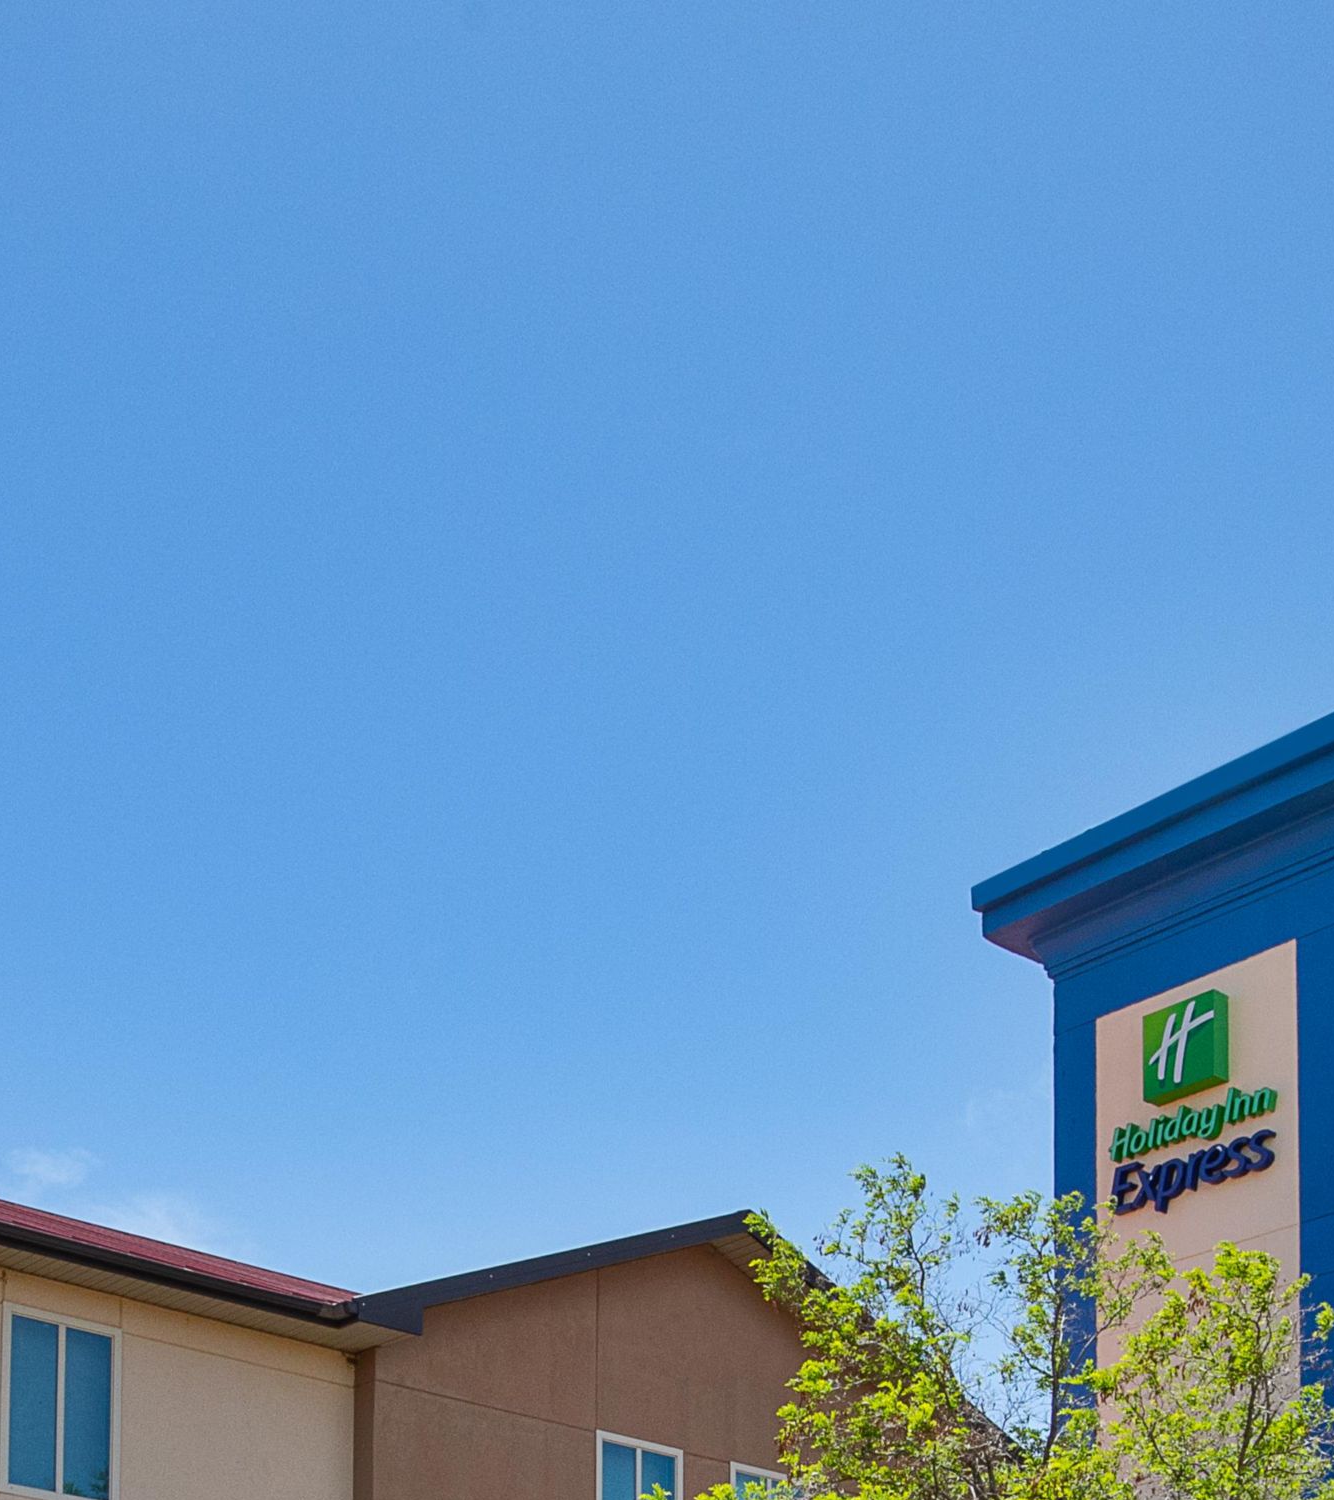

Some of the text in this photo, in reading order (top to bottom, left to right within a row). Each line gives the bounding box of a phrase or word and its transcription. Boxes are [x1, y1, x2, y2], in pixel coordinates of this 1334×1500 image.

[1109, 1087, 1278, 1162] Holiday Inn
[1110, 1129, 1276, 1216] Express
